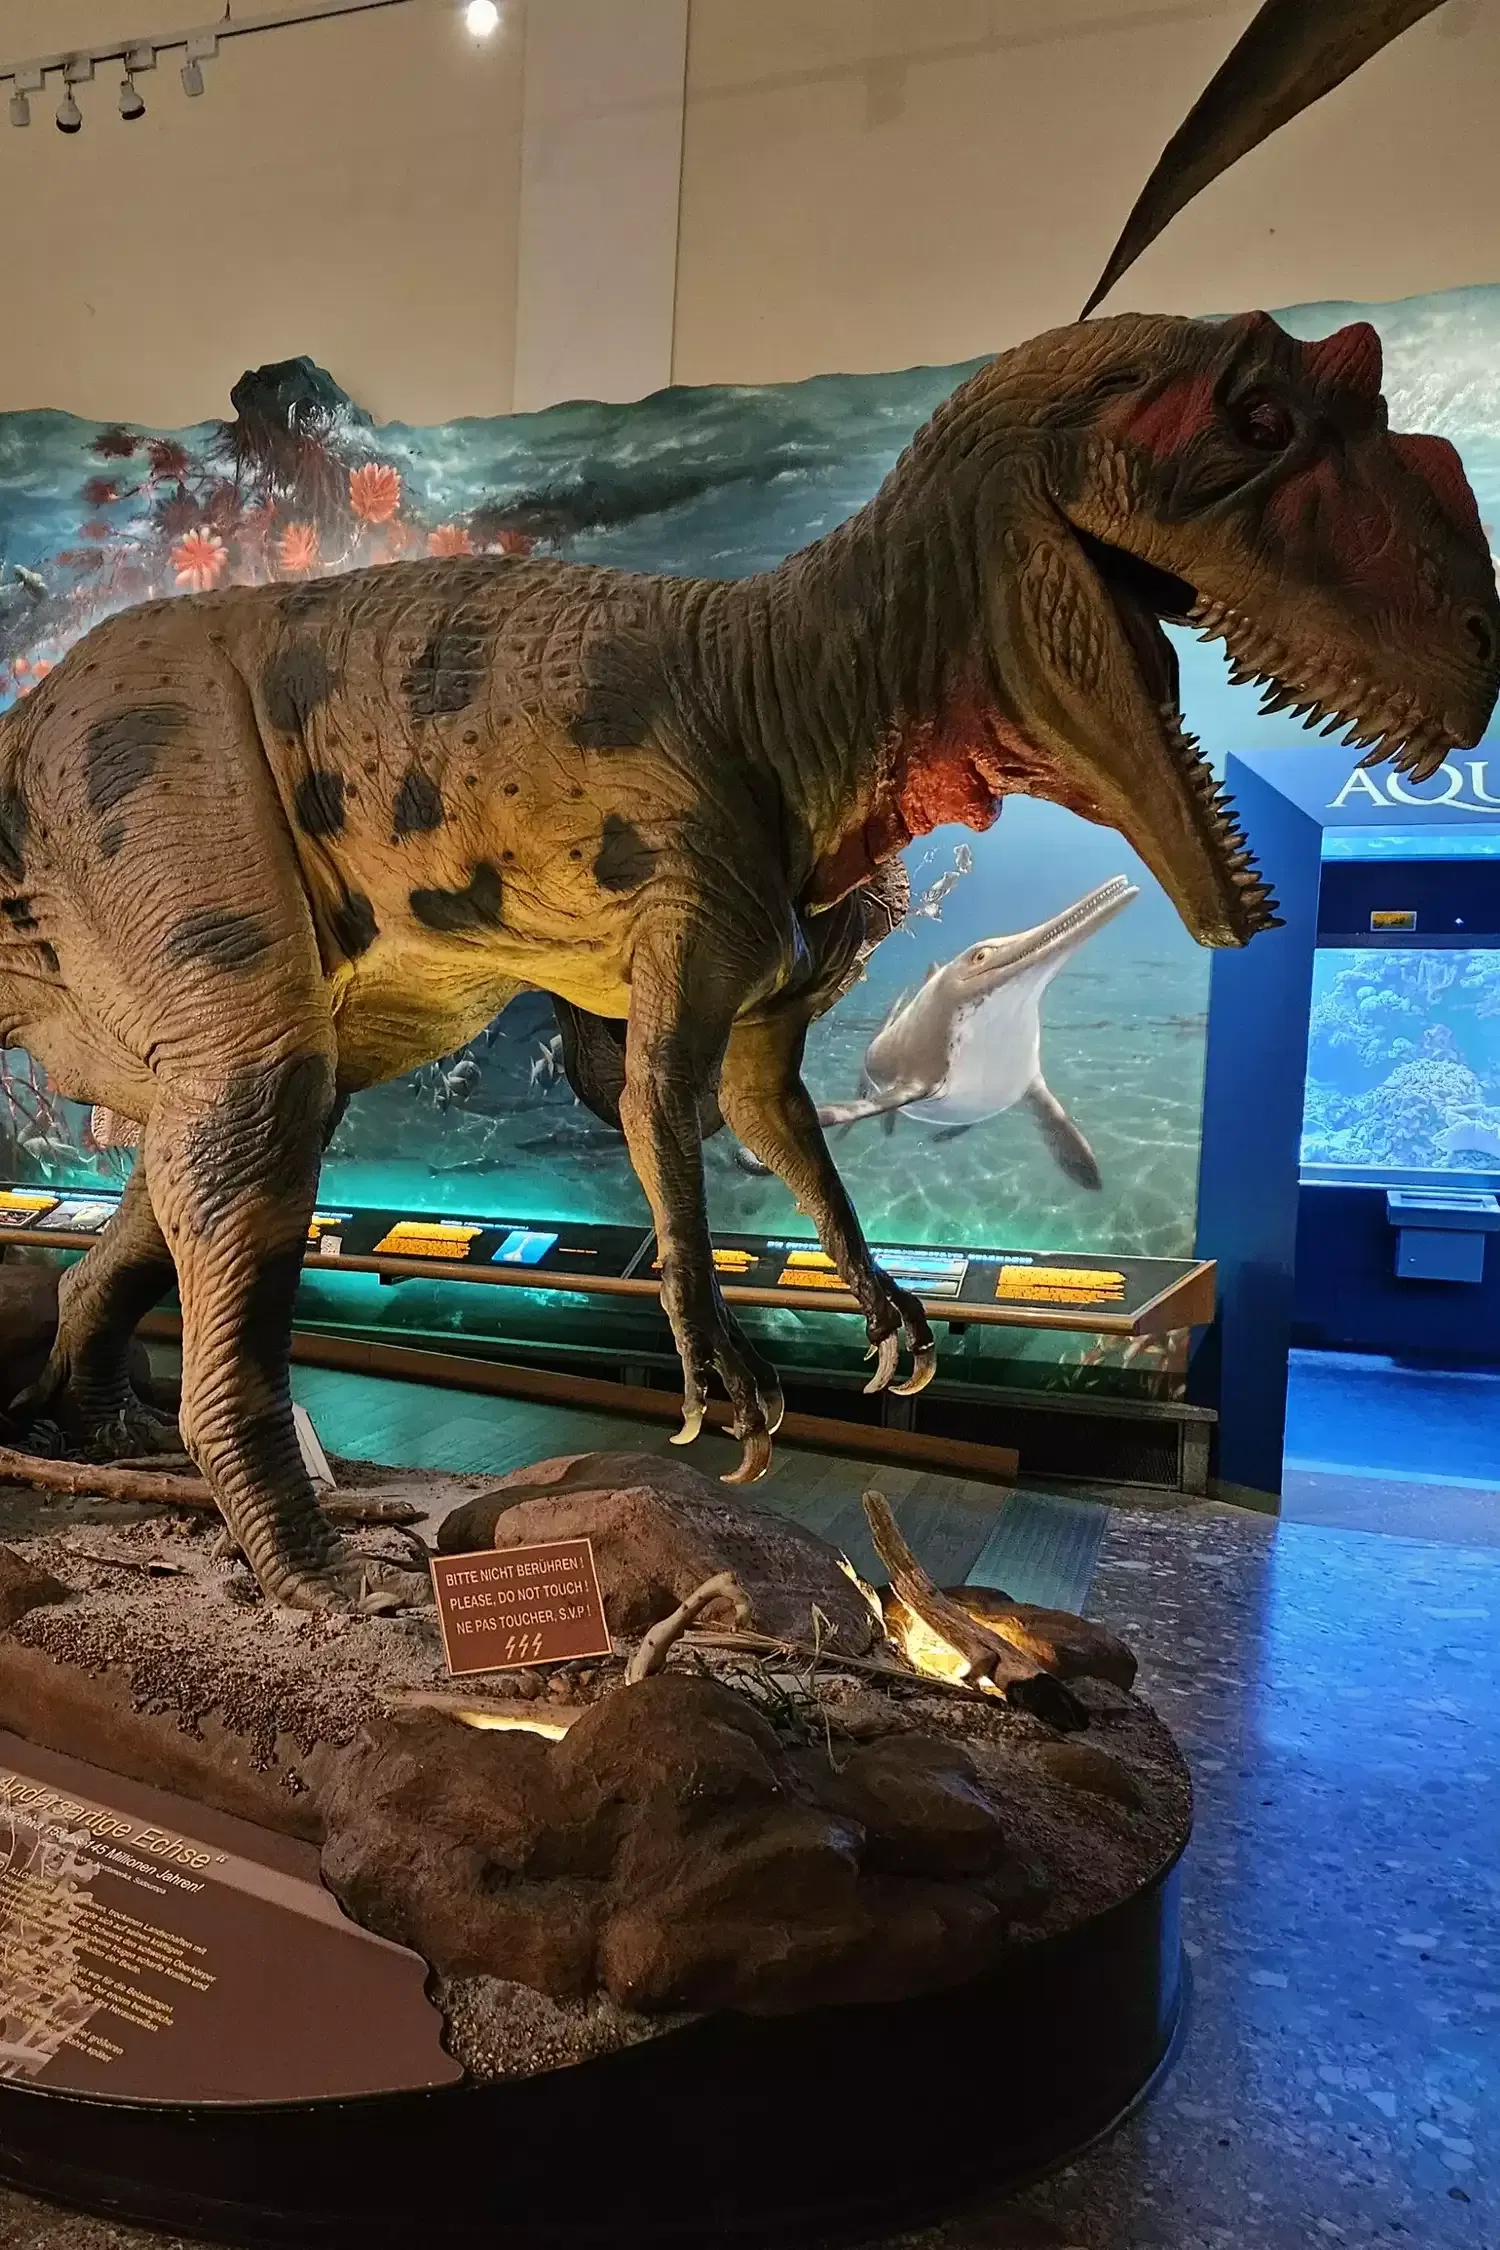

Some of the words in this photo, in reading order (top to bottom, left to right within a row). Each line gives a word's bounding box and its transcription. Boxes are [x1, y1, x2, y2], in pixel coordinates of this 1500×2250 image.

[446, 1570, 479, 1587] BITTE
[480, 1565, 514, 1582] NICHT
[517, 1557, 579, 1577] BERÜHREN
[450, 1593, 496, 1611] PLEASE,
[497, 1590, 515, 1604] DO
[517, 1586, 541, 1601] NOT
[543, 1581, 583, 1596] TOUCH
[456, 1621, 474, 1635] NE
[475, 1617, 497, 1632] PAS
[499, 1609, 558, 1629] TOUCHER,
[0, 1776, 132, 1838] Andersartige
[85, 1840, 109, 1855] 145
[105, 1847, 157, 1875] Millionen
[156, 1868, 205, 1893] Jahren!
[98, 1916, 114, 1927] sich
[113, 1922, 129, 1932] auf
[143, 1924, 194, 1951] Landschaften
[193, 1945, 208, 1956] mit
[191, 1977, 210, 1992] und
